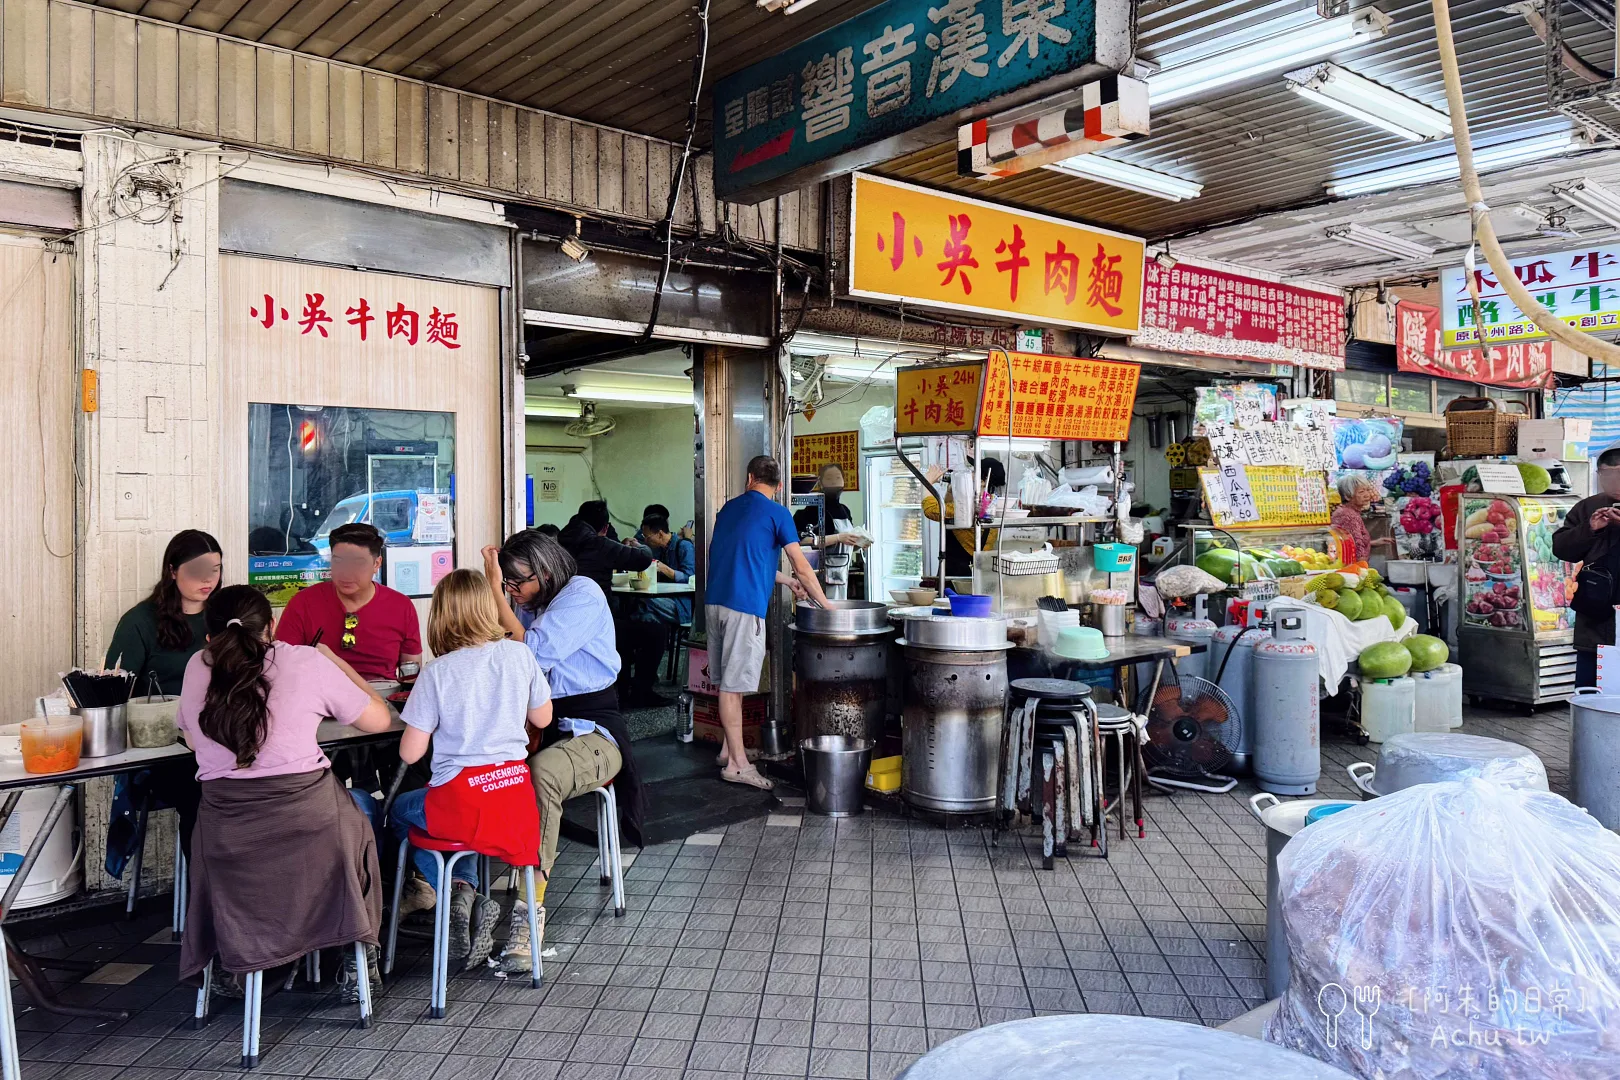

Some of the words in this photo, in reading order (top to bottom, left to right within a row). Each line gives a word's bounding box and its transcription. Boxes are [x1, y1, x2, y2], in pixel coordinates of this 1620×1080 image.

[877, 211, 1123, 318] 小吳牛肉麵
[1145, 265, 1159, 324] 冰紅茶
[1168, 269, 1180, 331] 百香果汁
[1198, 274, 1207, 320] 冬瓜茶
[1267, 288, 1276, 330] 西瓜汁
[250, 293, 461, 349] 小吳牛肉麵
[1025, 338, 1034, 349] 45
[917, 375, 950, 397] 小吳
[953, 370, 975, 385] 24H
[1025, 360, 1042, 416] 綜合麵
[1035, 361, 1052, 416] 麻醬麵
[1055, 362, 1071, 417] 牛肉湯麵
[1065, 362, 1081, 418] 牛肉湯
[1119, 369, 1136, 421] 各式小菜
[904, 397, 965, 427] 牛肉麵
[1239, 509, 1251, 519] 60
[468, 765, 528, 787] BRECKENRIDGE
[482, 776, 524, 793] COLORADO
